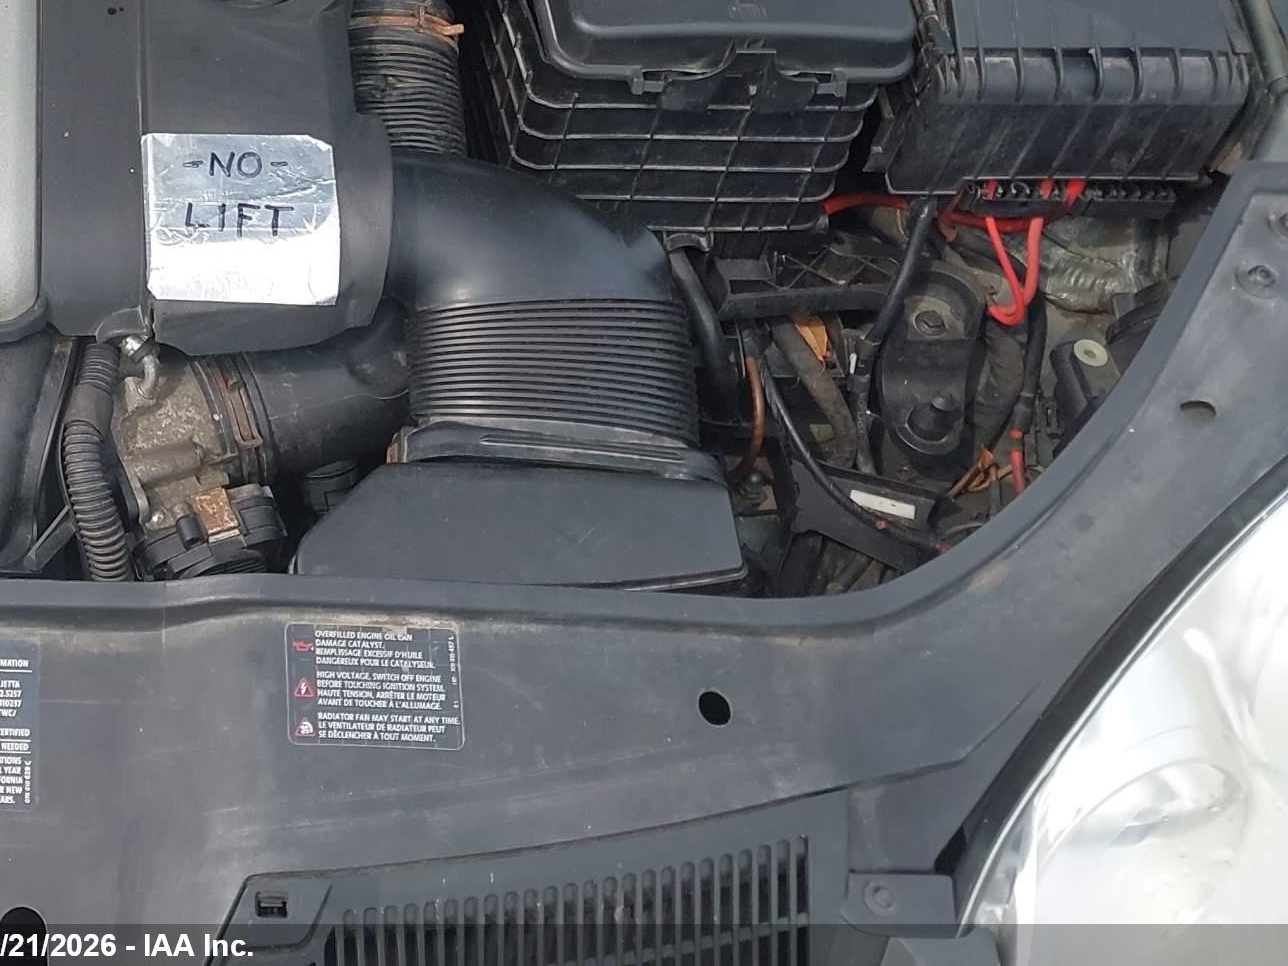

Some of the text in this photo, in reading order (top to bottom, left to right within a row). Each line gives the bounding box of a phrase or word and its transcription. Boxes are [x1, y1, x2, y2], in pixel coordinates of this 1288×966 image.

[185, 202, 294, 237] LIFT
[315, 630, 356, 638] OVERFILLED
[357, 632, 383, 640] ENGINE
[348, 640, 384, 648] CATALYST.
[316, 648, 361, 657] REMPLISSAGE
[394, 651, 422, 659] D'HUILE
[316, 657, 359, 665] DANGEREUX
[360, 658, 379, 666] POUR
[390, 659, 436, 669] CATALYSEUR.
[372, 673, 400, 681] SWITCH
[401, 674, 414, 682] OFF
[0, 680, 20, 688] JETTA
[317, 679, 342, 688] BEFORE
[344, 681, 381, 689] TOUCHING
[416, 684, 446, 692] SYSTEM.
[317, 689, 341, 697] HAUTE
[406, 692, 415, 700] LE
[416, 693, 446, 701] MOTEUR
[318, 698, 341, 706] AVANT
[395, 701, 442, 710] L'ALLUMAGE.
[318, 712, 354, 720] RADIATOR
[372, 714, 388, 722] MAY
[424, 716, 440, 724] ANY
[328, 722, 374, 730] VENTILATEUR
[376, 723, 385, 731] DE
[387, 724, 427, 732] RADIATEUR
[428, 725, 445, 733] PEUT
[319, 730, 327, 738] SE
[328, 730, 371, 739] DÉCLENCHER
[401, 733, 436, 742] MOMENT.
[1, 742, 29, 750] NEEDED
[4, 766, 21, 774] YEAR
[6, 786, 22, 794] NEW
